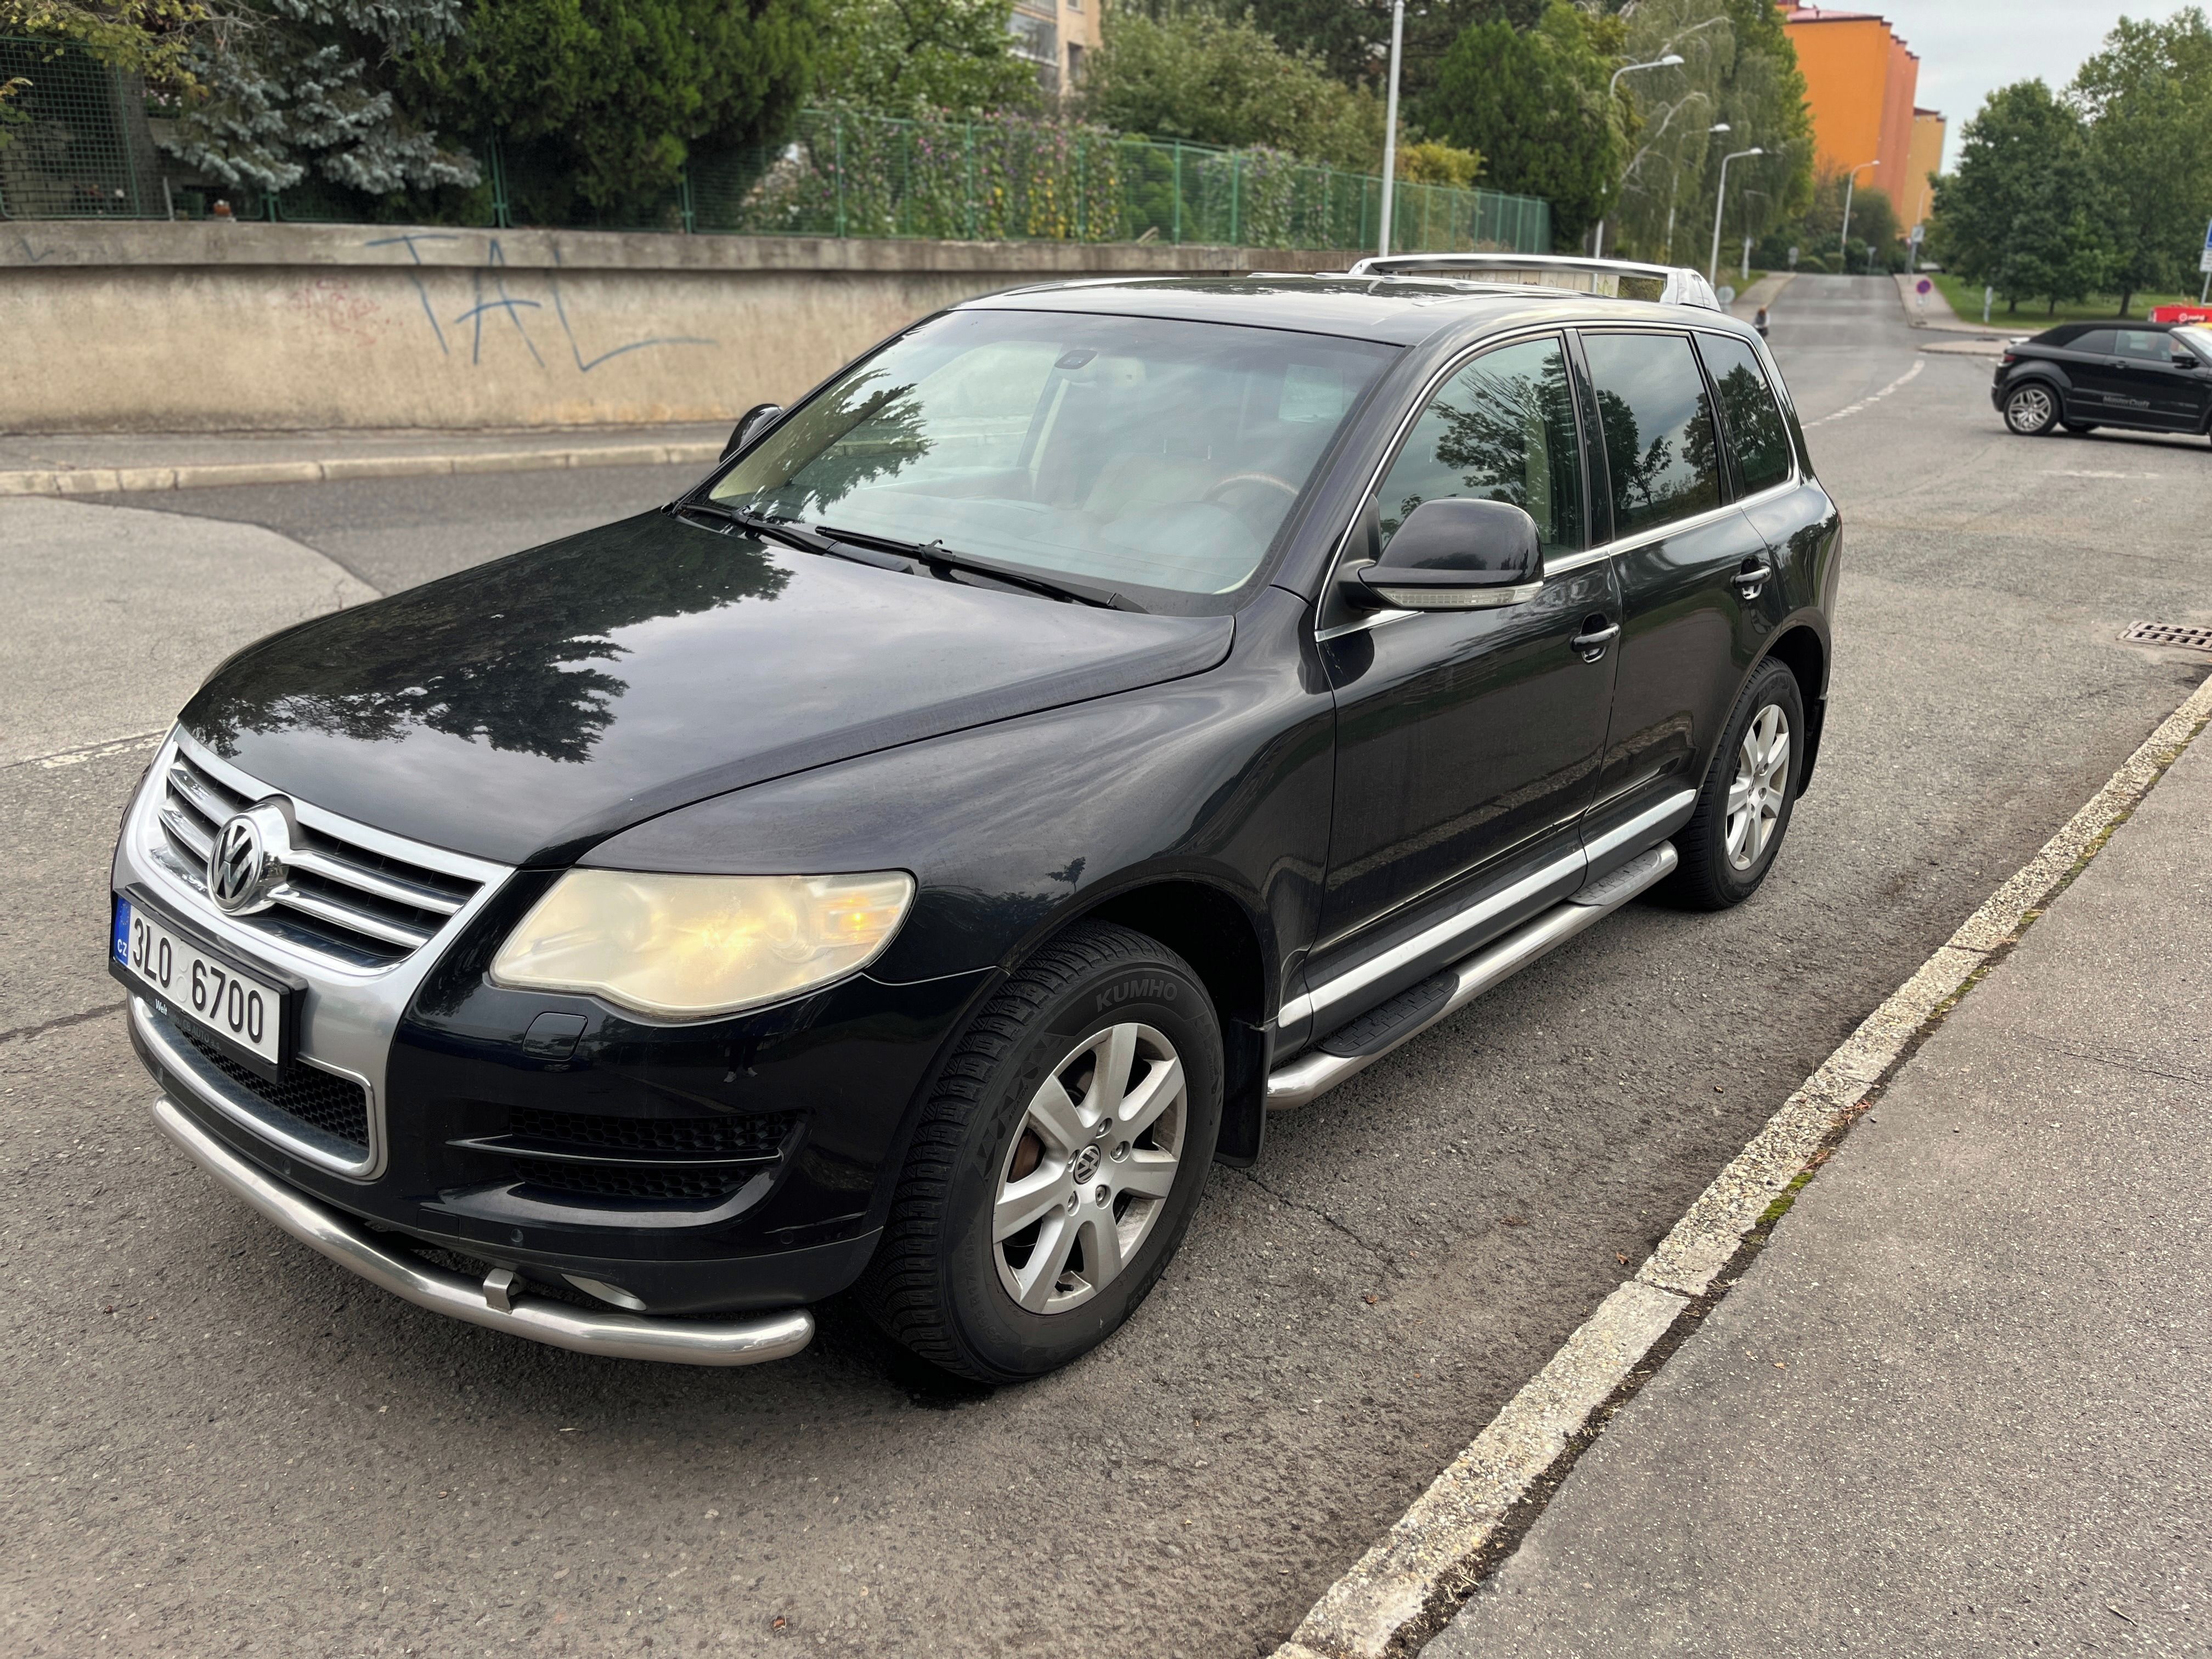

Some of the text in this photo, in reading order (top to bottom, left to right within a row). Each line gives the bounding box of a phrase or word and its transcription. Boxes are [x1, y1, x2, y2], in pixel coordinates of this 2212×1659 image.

[117, 939, 127, 957] CZ
[192, 959, 263, 1043] 6700
[1096, 978, 1178, 1013] KUMHO
[192, 1026, 209, 1042] AUTO
